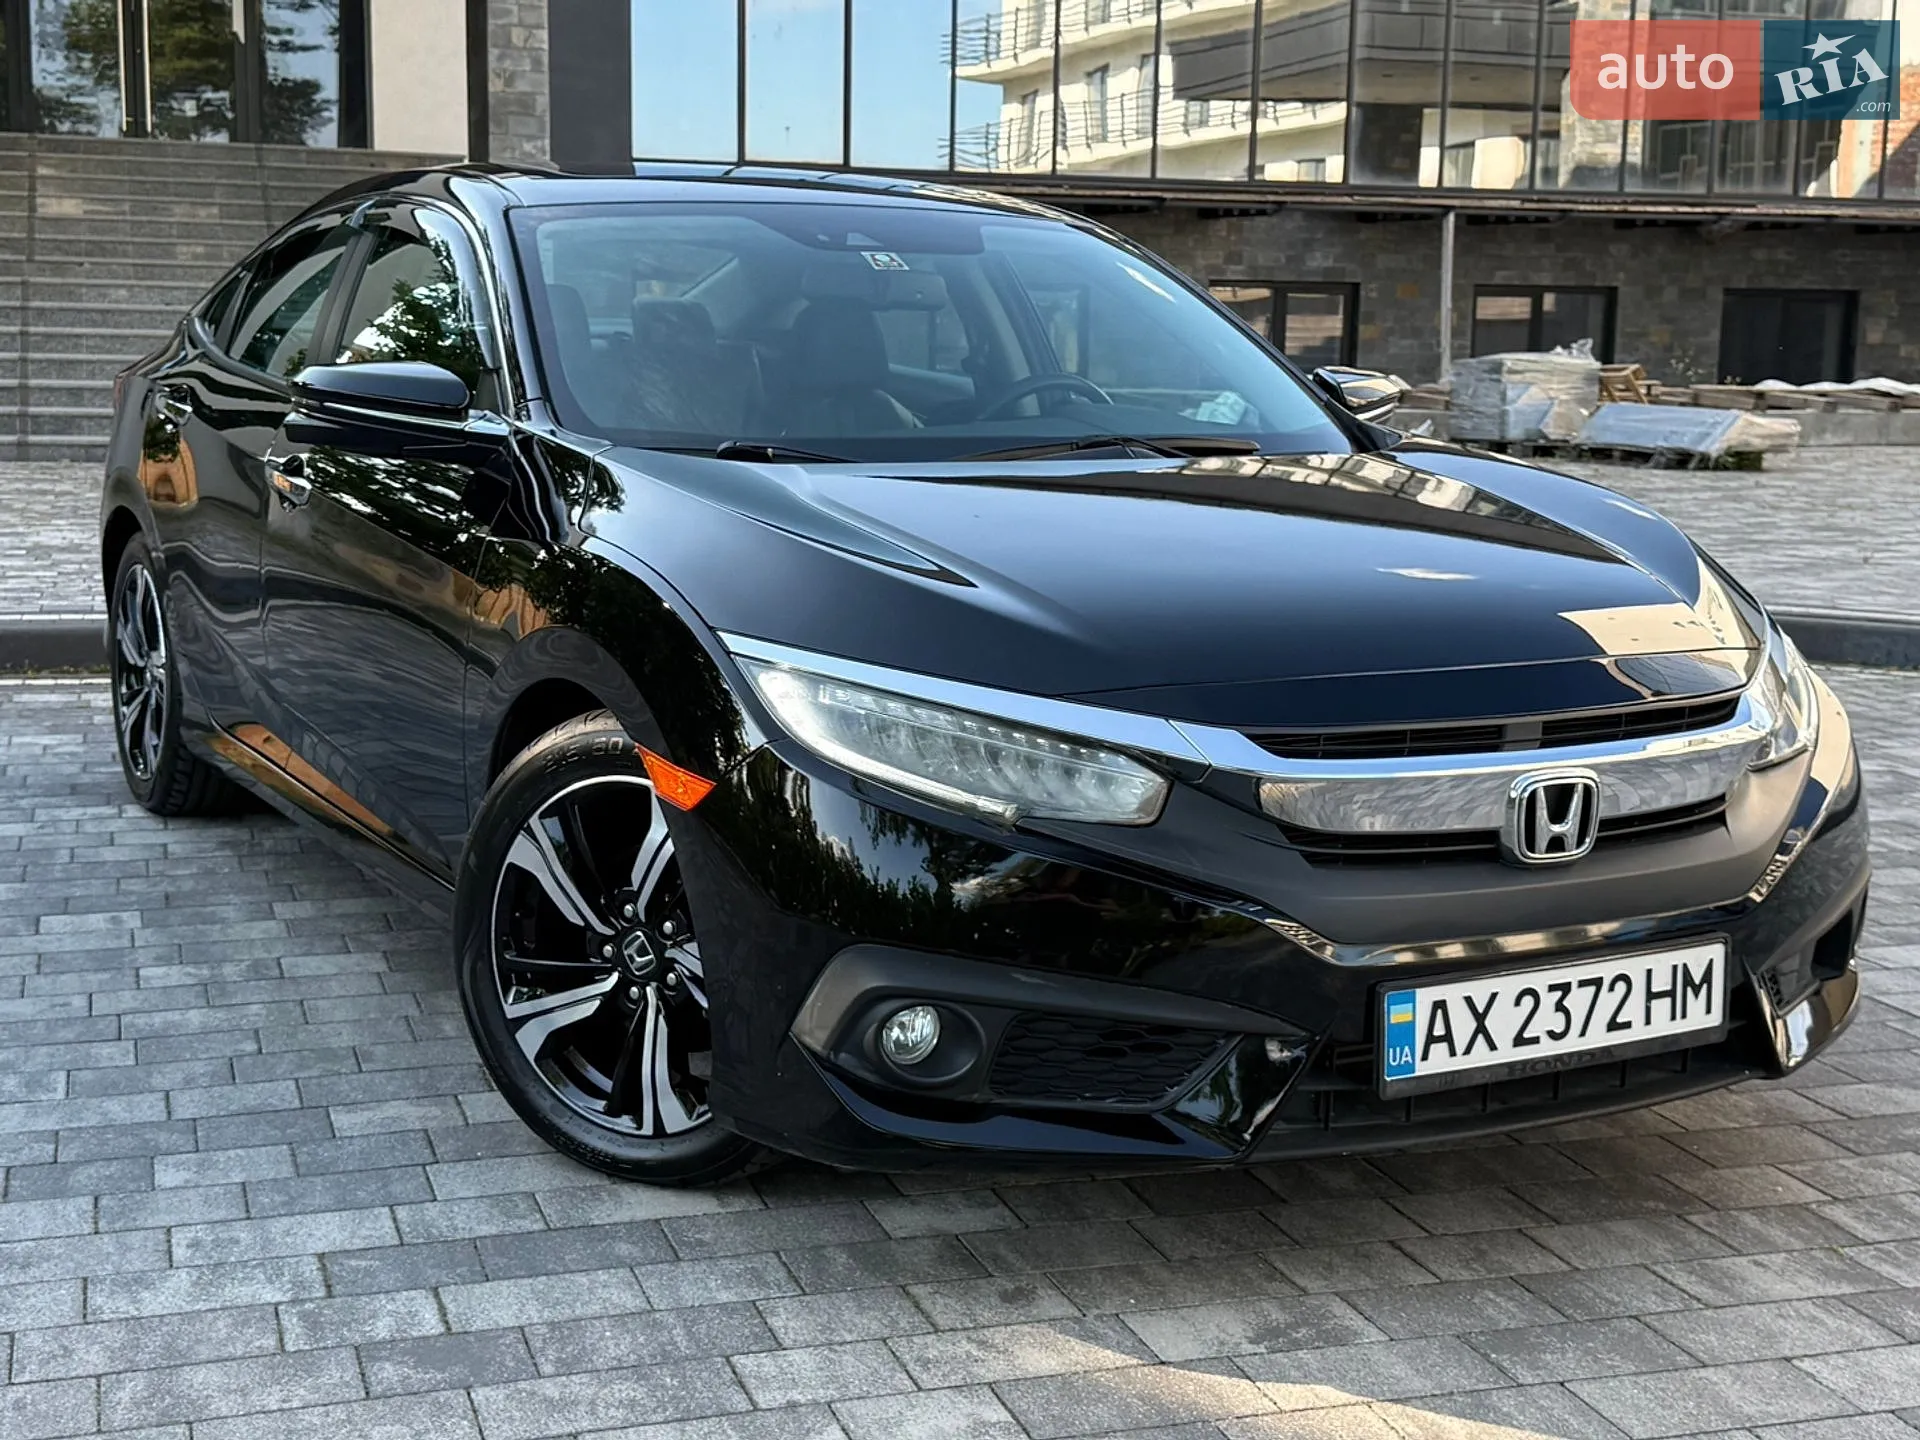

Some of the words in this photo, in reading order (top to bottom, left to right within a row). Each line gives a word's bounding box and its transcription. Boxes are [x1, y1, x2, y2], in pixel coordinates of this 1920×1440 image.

[1420, 991, 1499, 1062] AX
[1512, 973, 1633, 1048] 2372
[1644, 957, 1715, 1026] HM
[1389, 1045, 1413, 1066] UA
